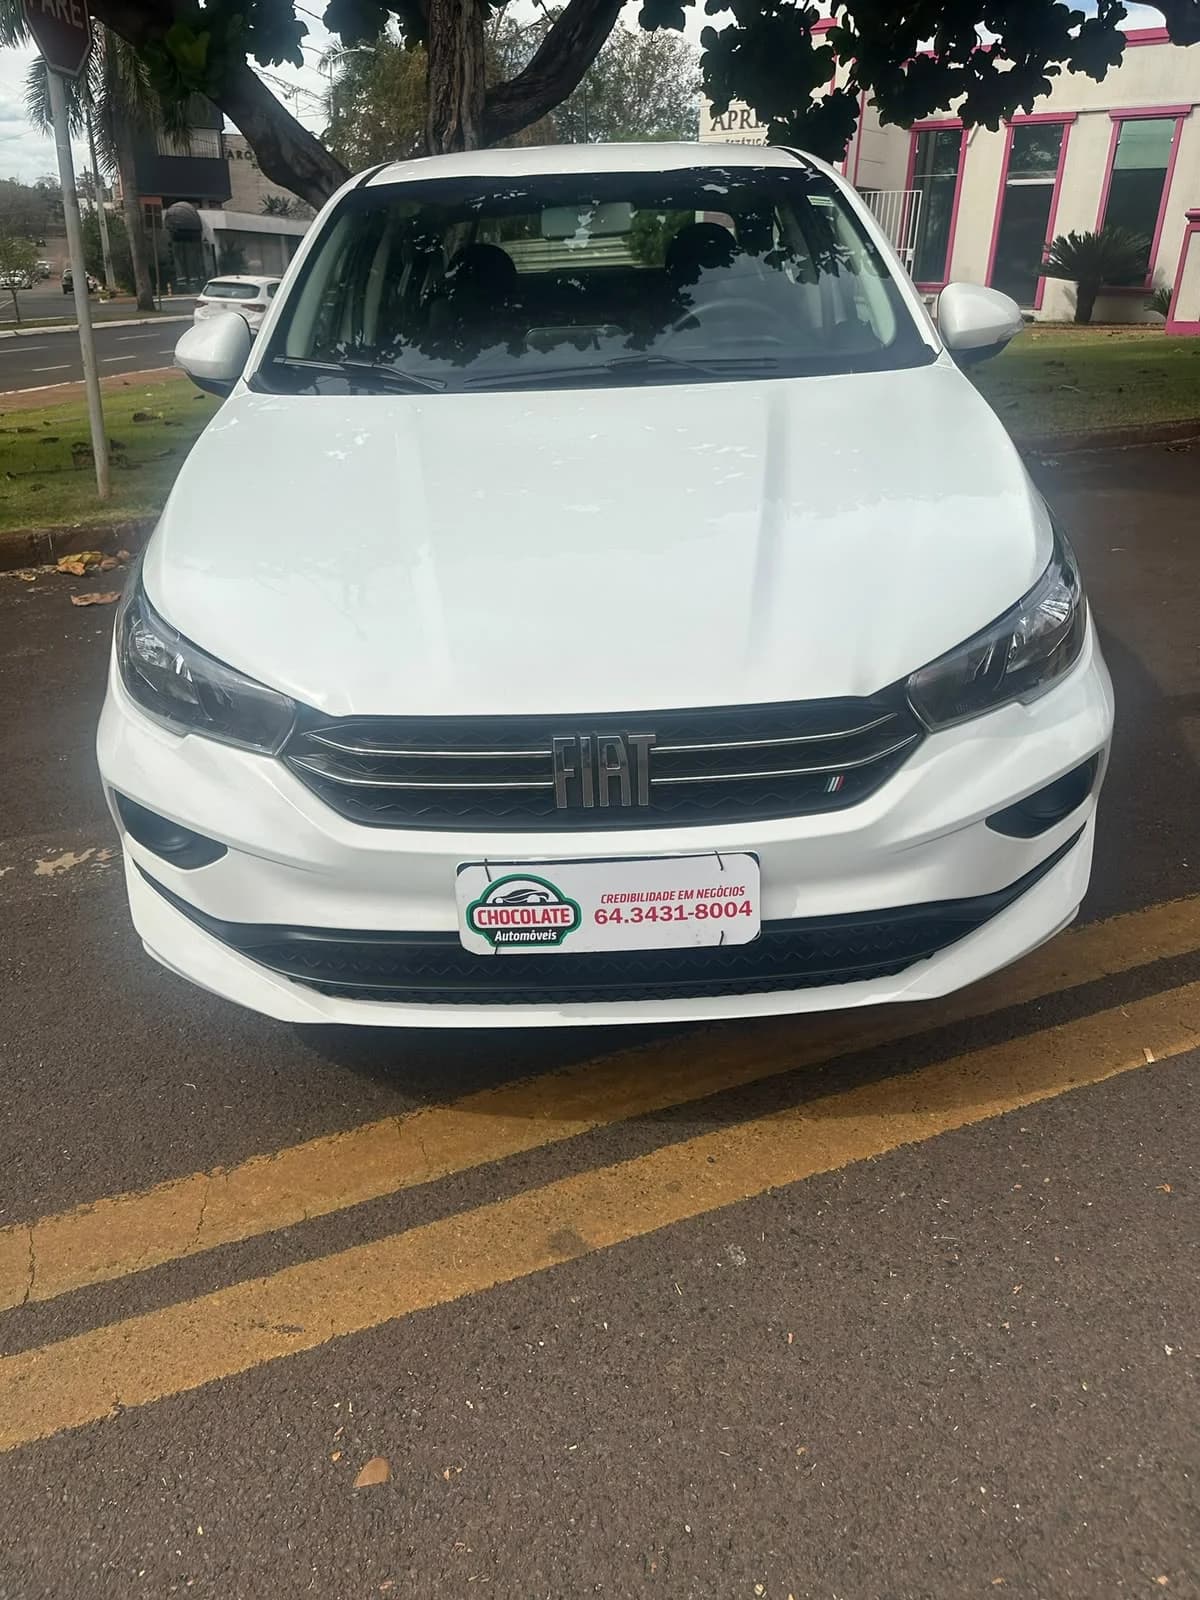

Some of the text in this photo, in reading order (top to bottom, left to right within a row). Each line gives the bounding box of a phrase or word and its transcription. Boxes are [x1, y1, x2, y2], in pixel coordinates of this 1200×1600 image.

[553, 734, 656, 808] FIAT
[601, 885, 745, 904] CREDIBILIDADE EM NEGÓCIOS
[477, 908, 570, 925] CHOCOLATE
[594, 900, 752, 925] 64.3431-8004
[495, 929, 557, 942] Automóveis
